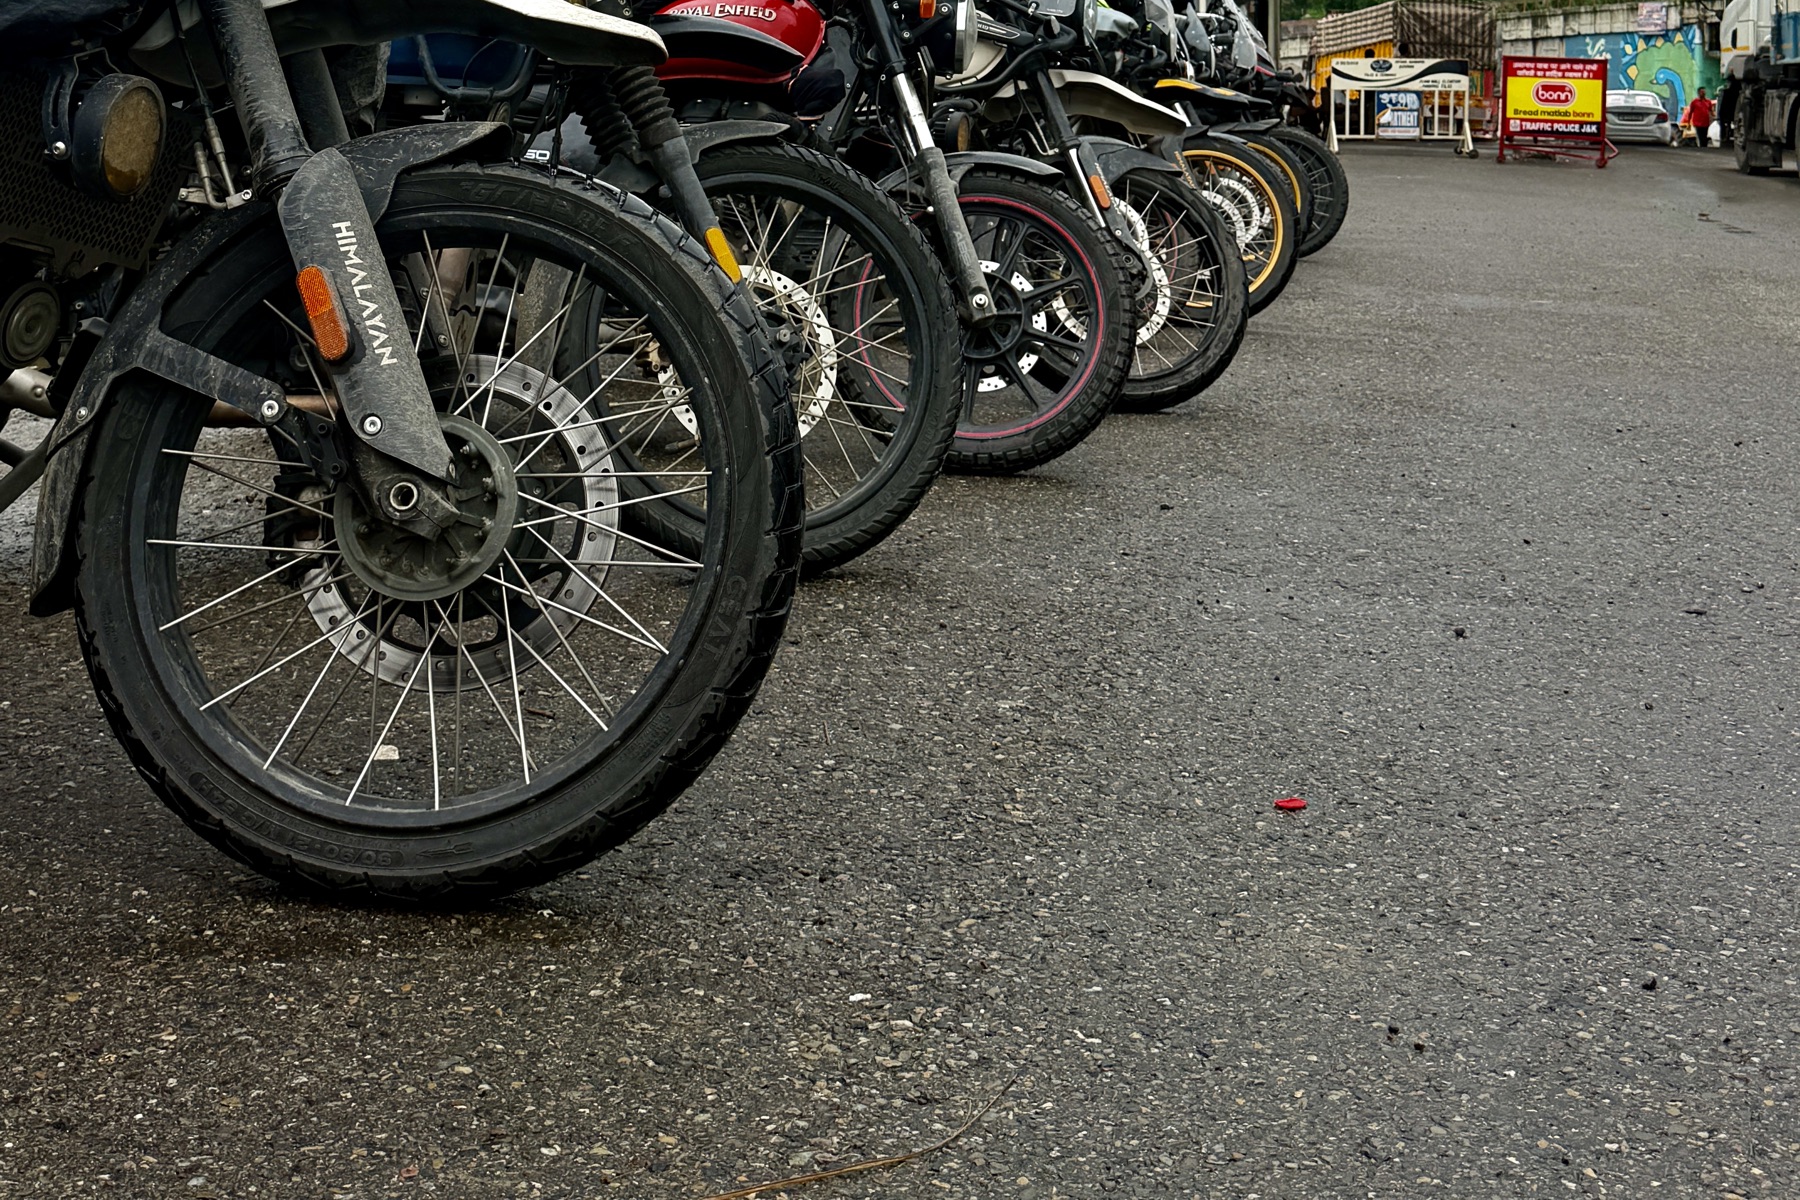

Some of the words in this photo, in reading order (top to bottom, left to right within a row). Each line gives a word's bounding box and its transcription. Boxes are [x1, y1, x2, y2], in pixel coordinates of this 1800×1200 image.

[714, 2, 777, 21] ENFIELD
[1538, 84, 1571, 100] bonn
[1513, 108, 1539, 116] Bread
[1540, 109, 1571, 118] matlab
[1572, 110, 1594, 118] bonn
[1521, 121, 1551, 131] TRAFFIC
[1553, 122, 1580, 132] POLICE
[1580, 123, 1598, 133] J&K
[331, 221, 398, 366] HIMALAYAN
